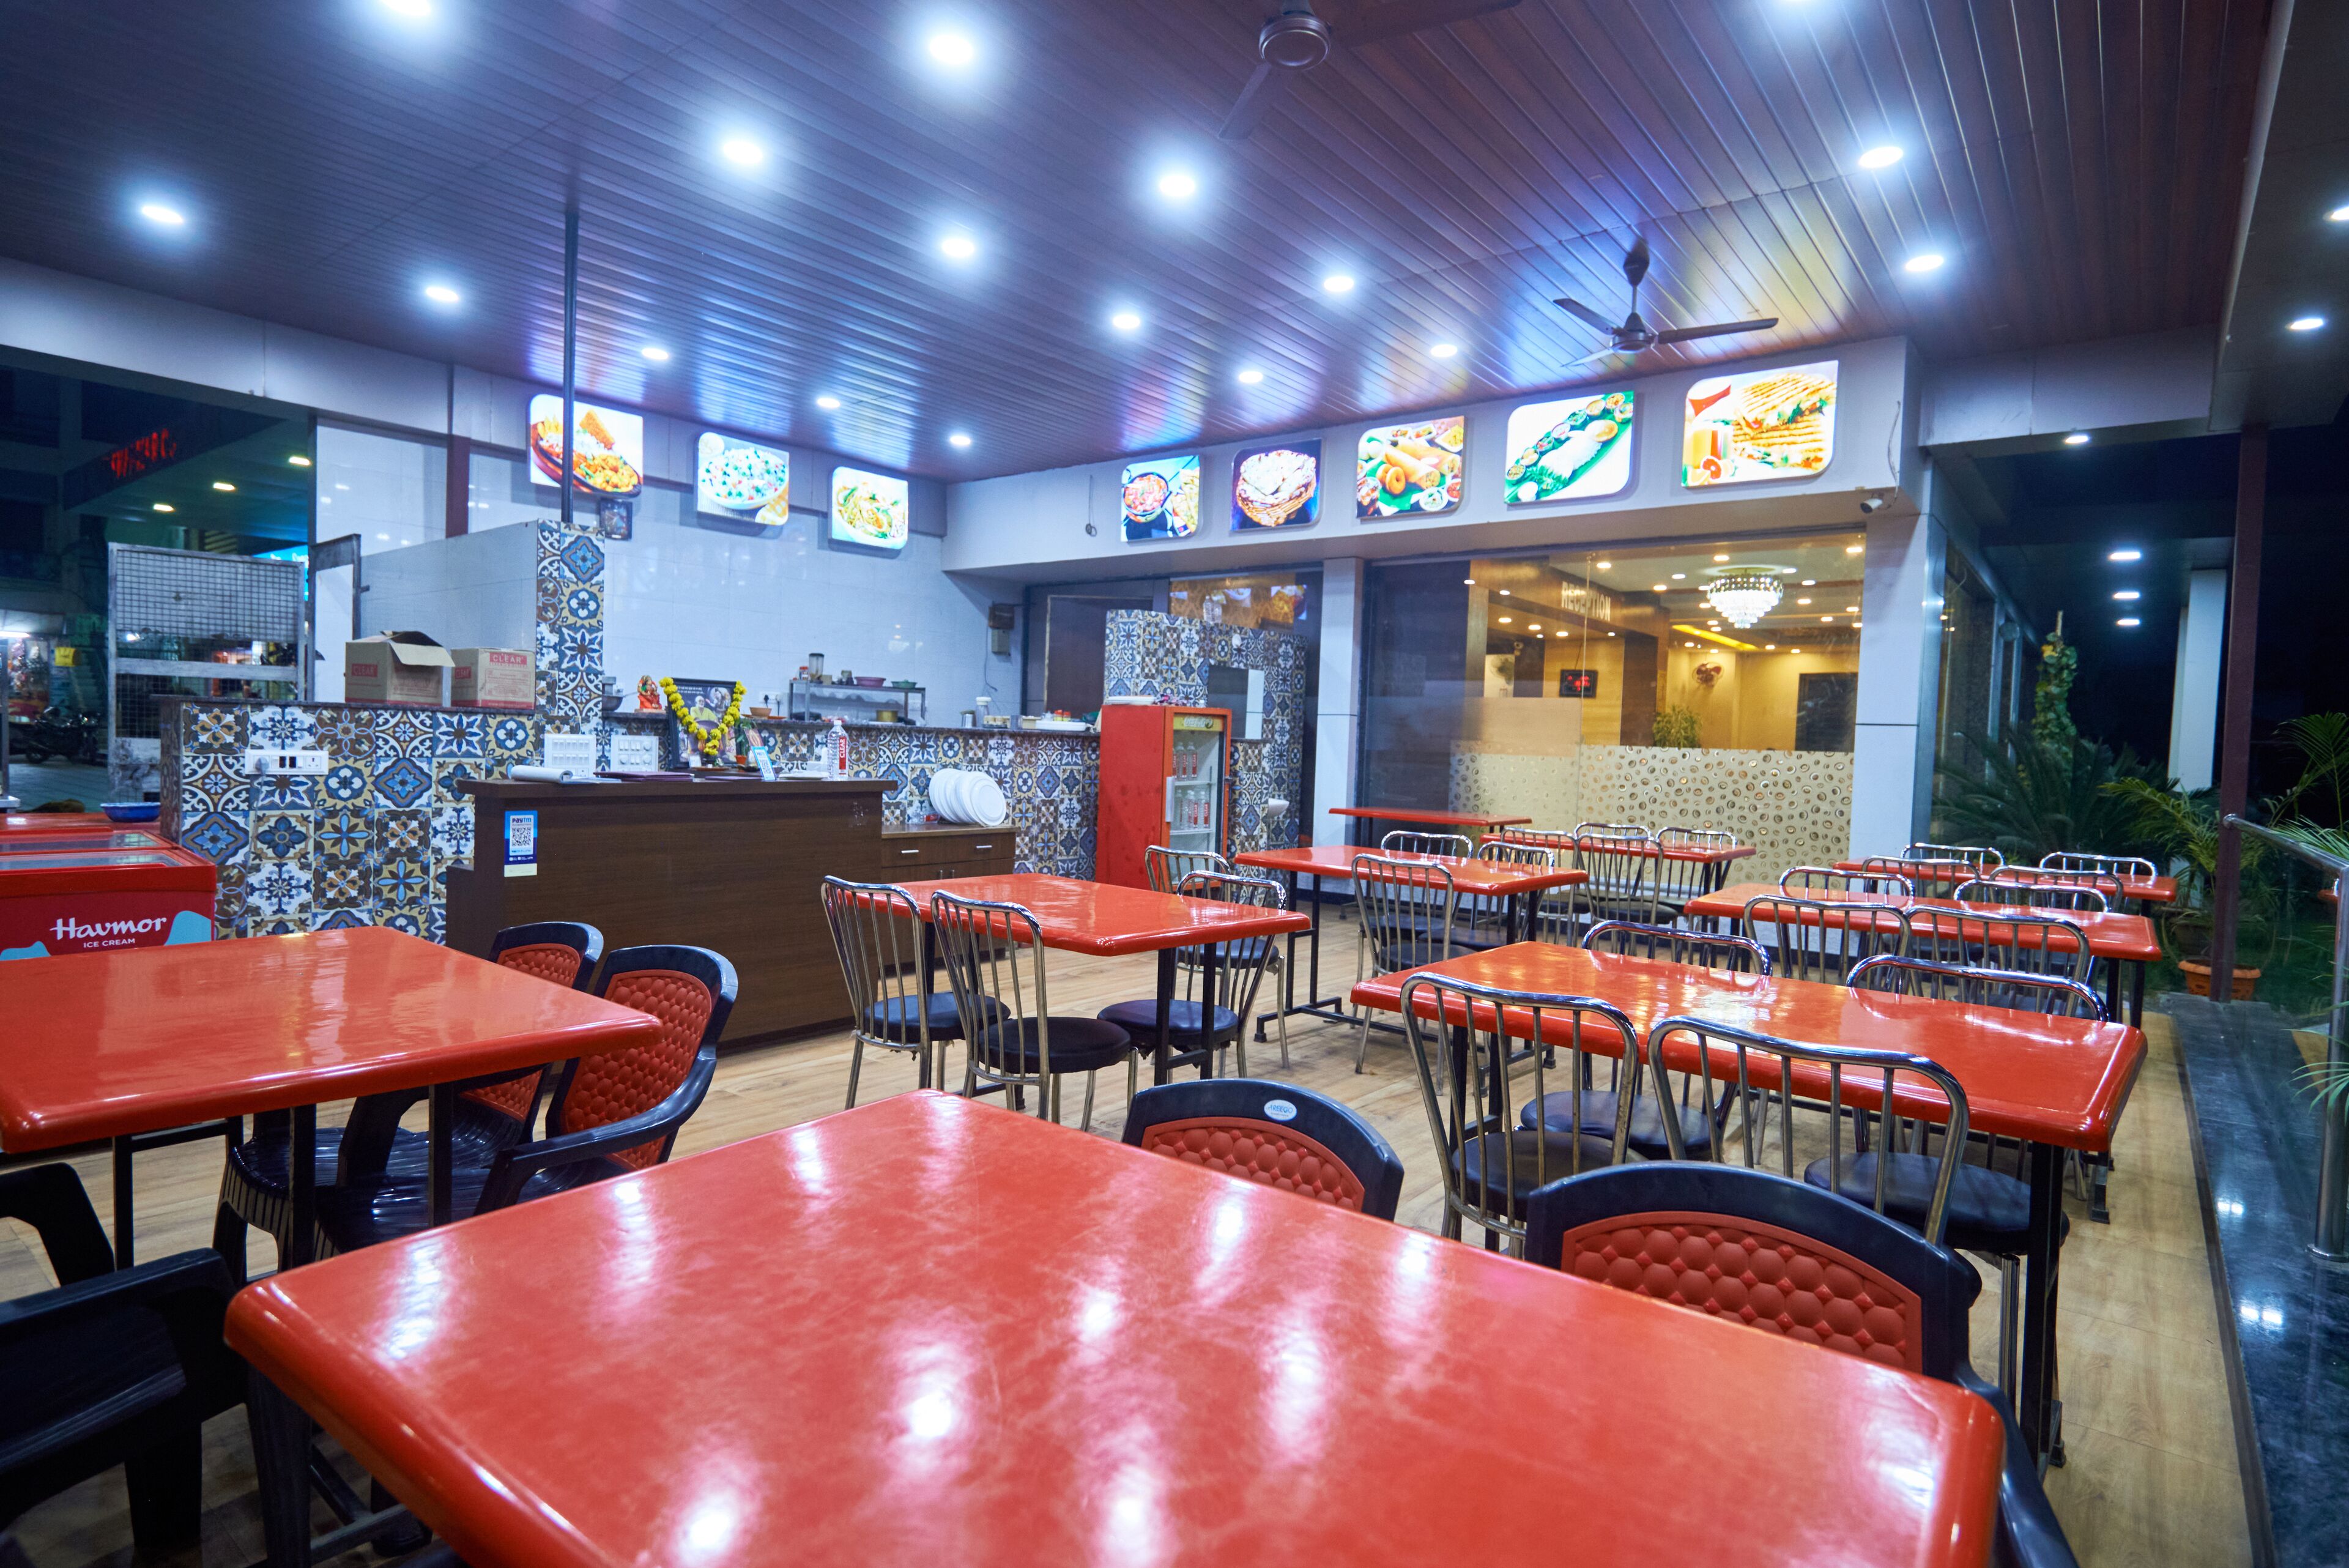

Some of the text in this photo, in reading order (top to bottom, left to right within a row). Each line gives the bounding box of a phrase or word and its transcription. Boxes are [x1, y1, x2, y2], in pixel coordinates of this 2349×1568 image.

[493, 654, 521, 664] CLEAR
[49, 917, 167, 940] Havmor
[102, 938, 136, 947] CREAM
